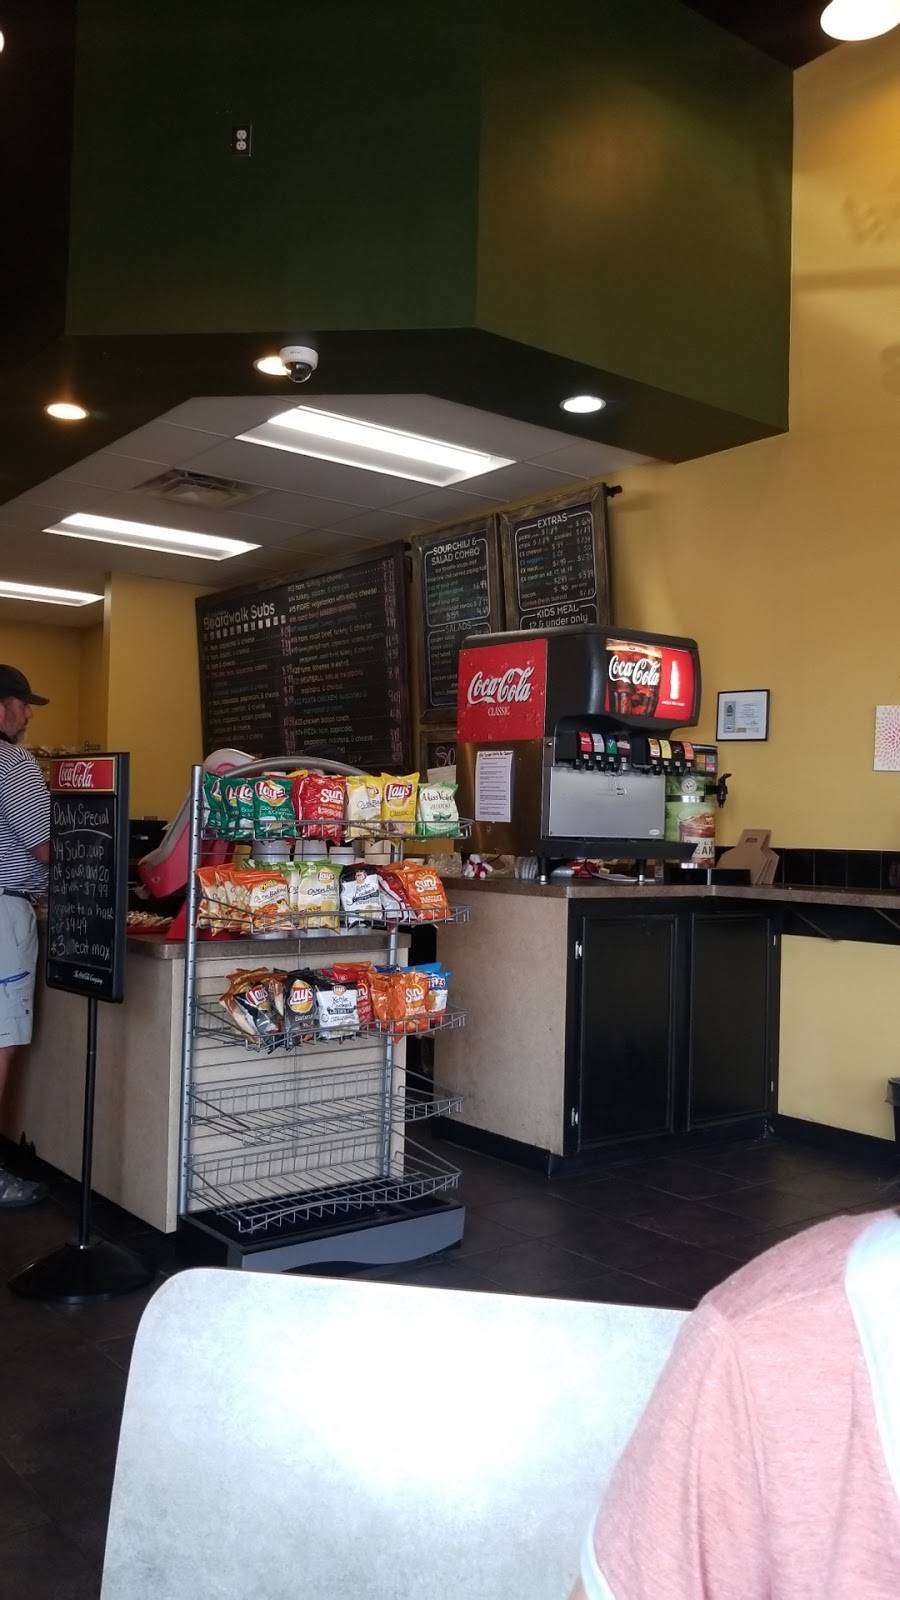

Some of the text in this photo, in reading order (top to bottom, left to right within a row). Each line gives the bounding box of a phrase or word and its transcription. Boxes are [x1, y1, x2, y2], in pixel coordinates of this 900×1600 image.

[537, 513, 568, 529] EXTRAS
[432, 546, 480, 566] SALAD COMBO
[204, 606, 250, 632] Boardwalk
[250, 602, 276, 620] Subs
[537, 604, 580, 620] KIDS MEAL
[445, 622, 472, 634] SALADS
[546, 616, 568, 628] under
[570, 613, 589, 624] only
[608, 655, 661, 686] Coca-Cola
[467, 667, 535, 705] Coca-Cola
[488, 706, 510, 716] CLASSIC
[59, 762, 95, 788] Coca-Cola
[320, 788, 343, 803] Sun
[388, 785, 411, 800] Lay's
[54, 802, 110, 833] Daily Special
[98, 866, 110, 883] 20
[416, 879, 435, 893] Sun
[92, 942, 111, 961] max
[290, 988, 314, 1005] Lay's
[405, 987, 424, 1003] Sun
